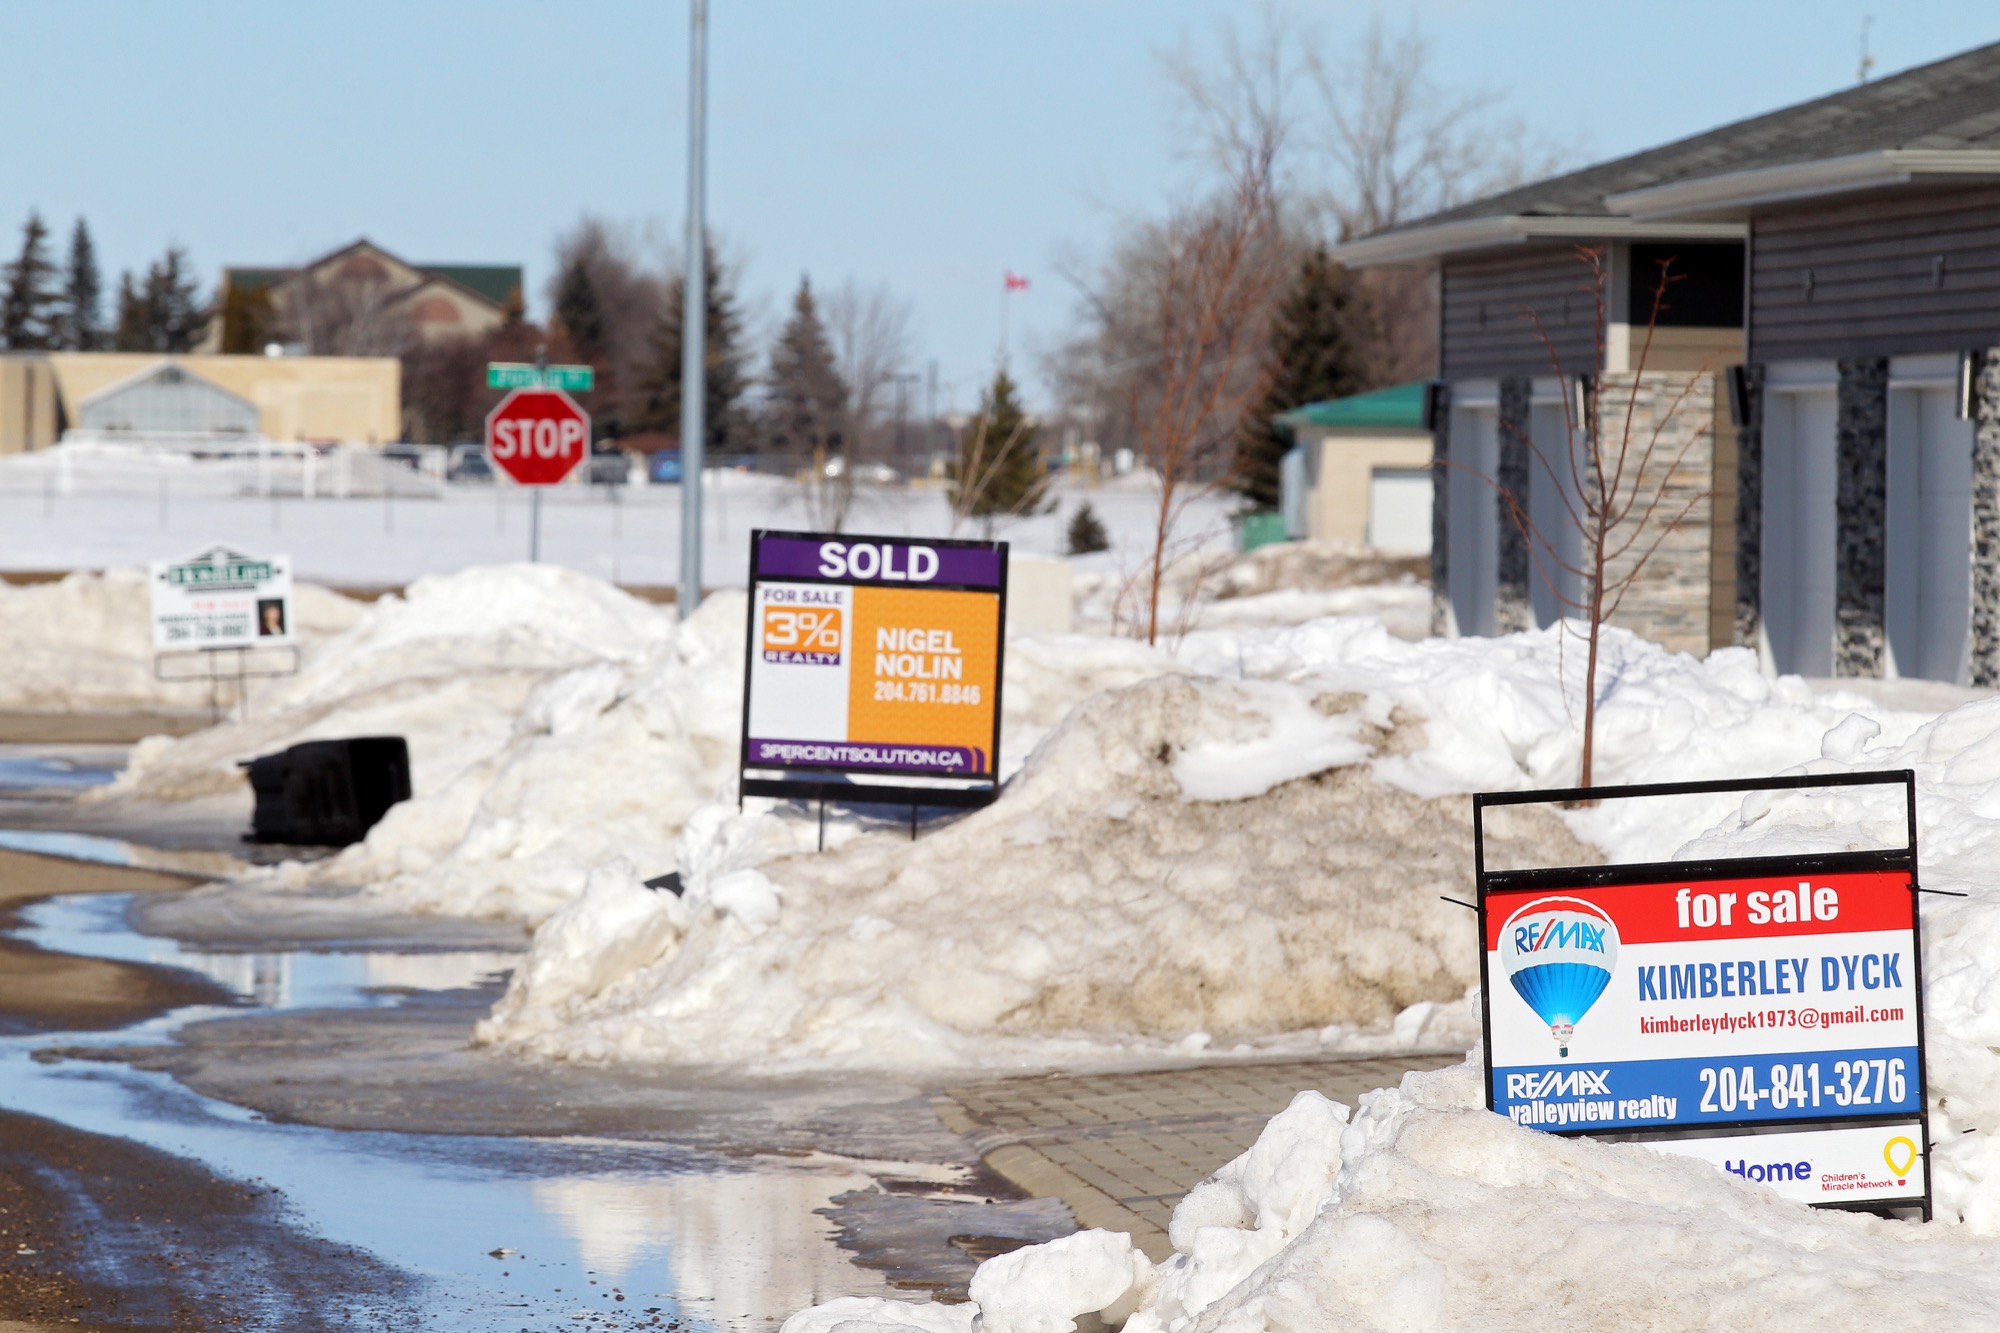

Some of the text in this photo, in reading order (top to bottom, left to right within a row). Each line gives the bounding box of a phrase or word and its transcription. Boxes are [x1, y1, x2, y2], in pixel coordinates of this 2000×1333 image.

[494, 419, 583, 459] STOP
[818, 542, 940, 582] SOLD
[763, 588, 843, 605] FOR SALE
[764, 611, 840, 648] 3%
[876, 626, 962, 654] NIGEL
[765, 651, 840, 665] REALTY
[875, 653, 963, 680] NOLIN
[760, 742, 964, 766] 3PERCENTSOLUTION.CA
[1675, 882, 1840, 929] for sale
[1514, 918, 1606, 956] RE/MAX
[1638, 952, 1903, 1001] KIMBERLEY DYCK
[1640, 1005, 1905, 1035] kimberleydyck1973@gmail.com
[1506, 1069, 1612, 1100] RE/MAX
[1699, 1057, 1907, 1114] 204-841-3276
[1508, 1094, 1678, 1126] valleyview realty
[1725, 1159, 1812, 1183] Home
[1821, 1172, 1866, 1183] Children's
[1821, 1179, 1894, 1192] Miracle Network
